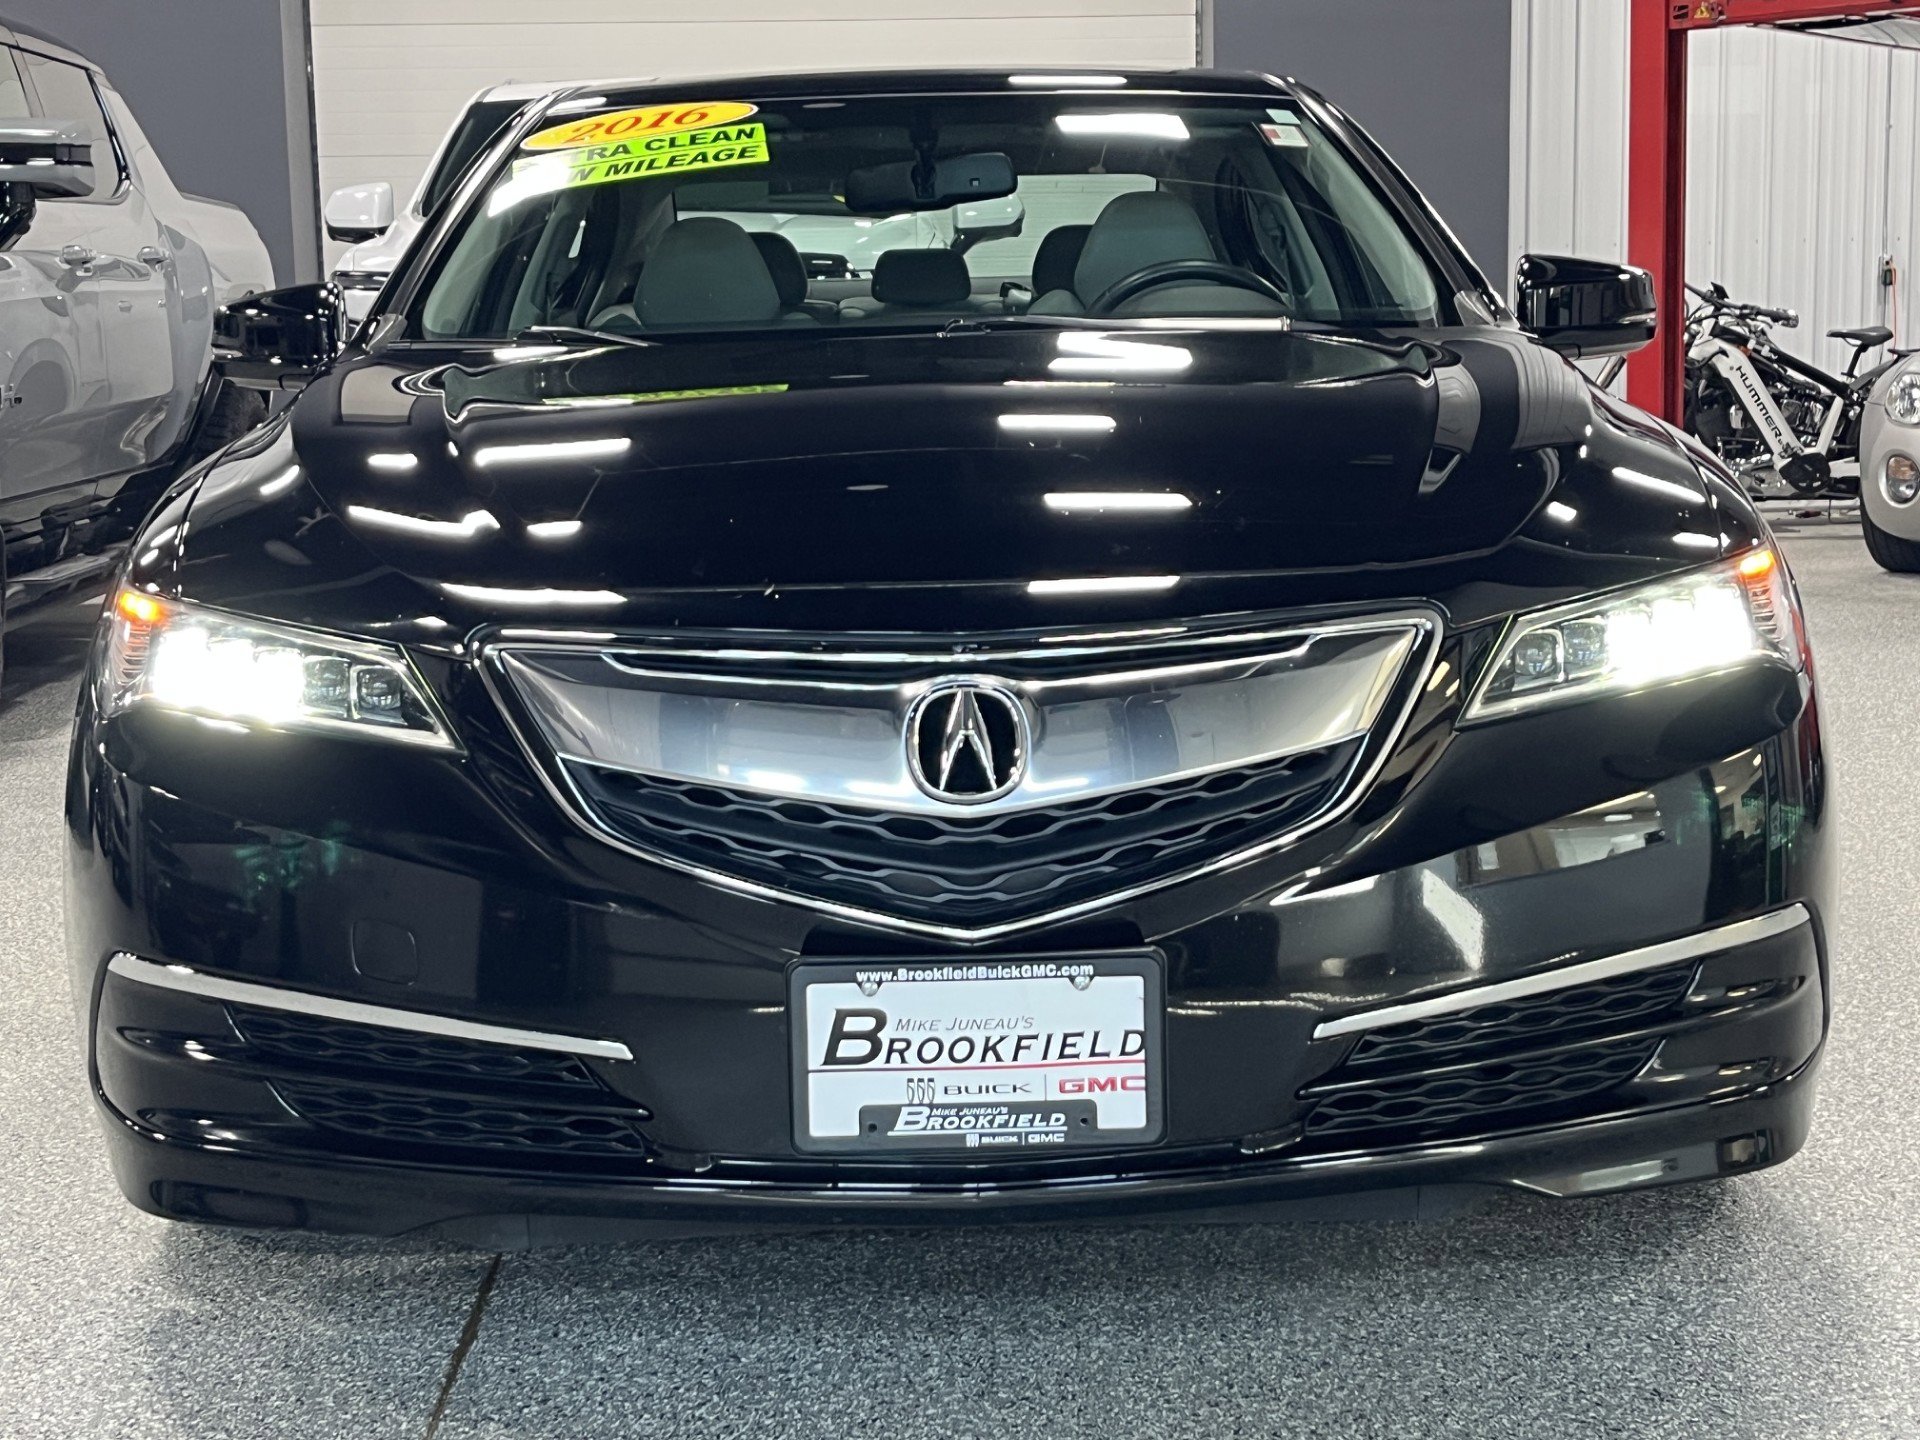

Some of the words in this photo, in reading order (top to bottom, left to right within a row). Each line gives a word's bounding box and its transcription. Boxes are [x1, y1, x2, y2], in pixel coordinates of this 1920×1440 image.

[562, 105, 717, 143] 2016
[645, 127, 756, 151] CLEAN
[604, 145, 760, 178] MILEAGE
[1735, 366, 1782, 439] HUMMER
[856, 964, 1094, 982] www.BrookfieldBuickGMC.com
[895, 1018, 942, 1032] MIKE
[945, 1016, 1034, 1032] JUNEAU'S
[820, 1007, 1145, 1067] BROOKFIELD
[944, 1083, 1032, 1095] BUICK
[1059, 1075, 1145, 1094] GMC
[894, 1106, 1066, 1131] BROOKFIELD
[931, 1107, 957, 1116] MIKE
[981, 1135, 1019, 1144] BUICK
[1028, 1133, 1065, 1143] GMC
